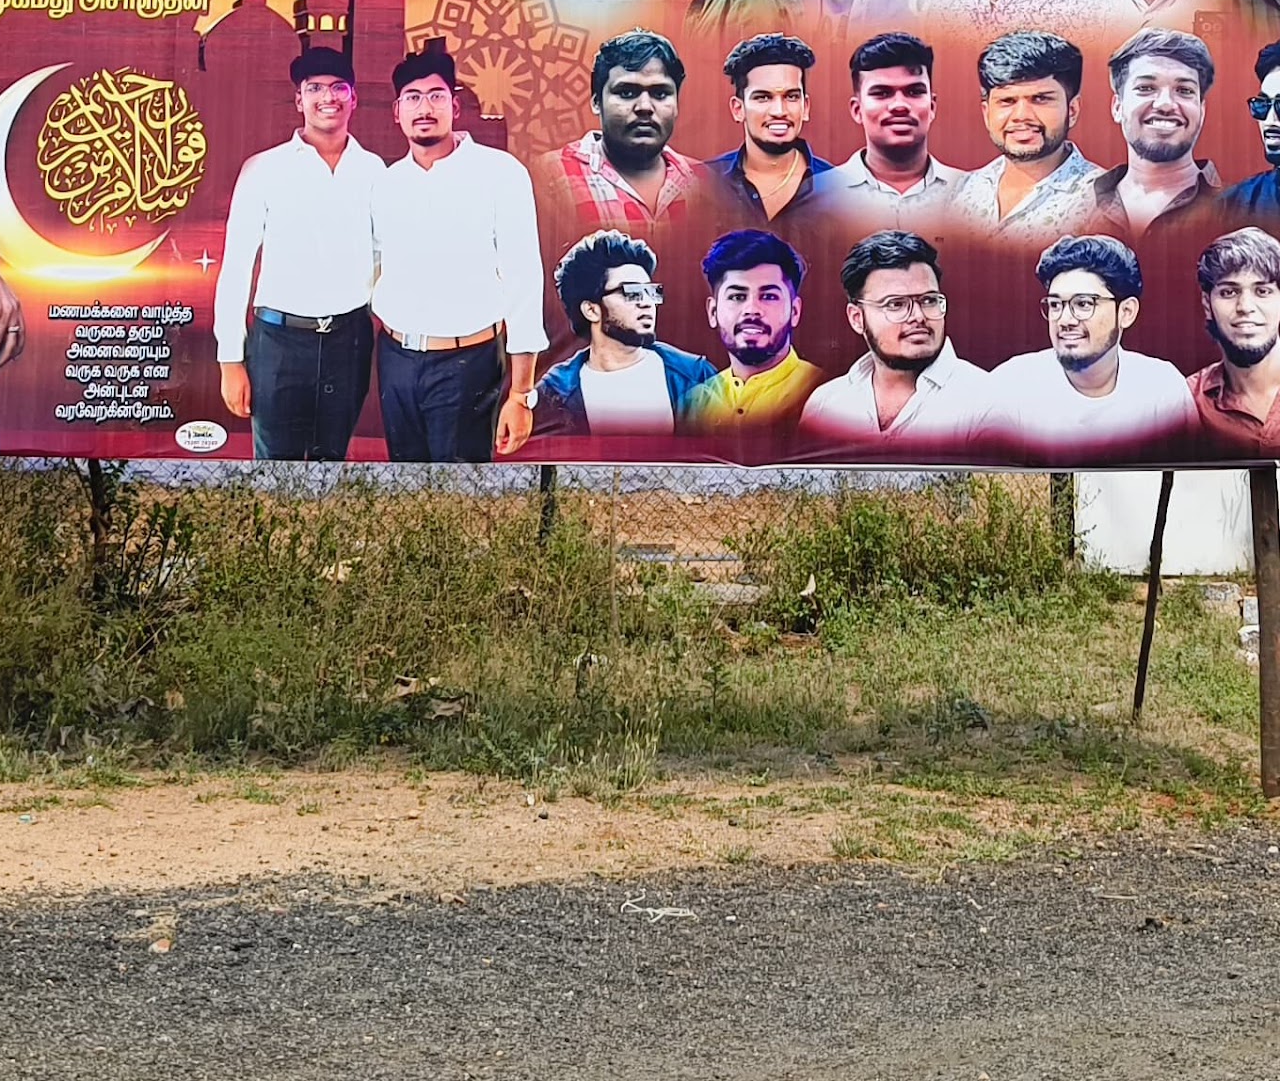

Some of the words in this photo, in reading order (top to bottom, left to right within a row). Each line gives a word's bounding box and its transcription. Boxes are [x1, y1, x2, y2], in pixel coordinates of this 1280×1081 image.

[48, 300, 139, 319] மணமக்களை
[141, 300, 193, 325] வாழ்த்த
[75, 324, 126, 343] வருகை
[126, 320, 164, 344] தரும்
[66, 340, 171, 362] அனைவரையும்
[65, 364, 102, 382] வருக
[104, 364, 140, 382] வருக
[143, 364, 170, 379] என
[83, 381, 150, 403] அன்புடன்
[55, 400, 175, 423] வரவேற்கின்றோம்.
